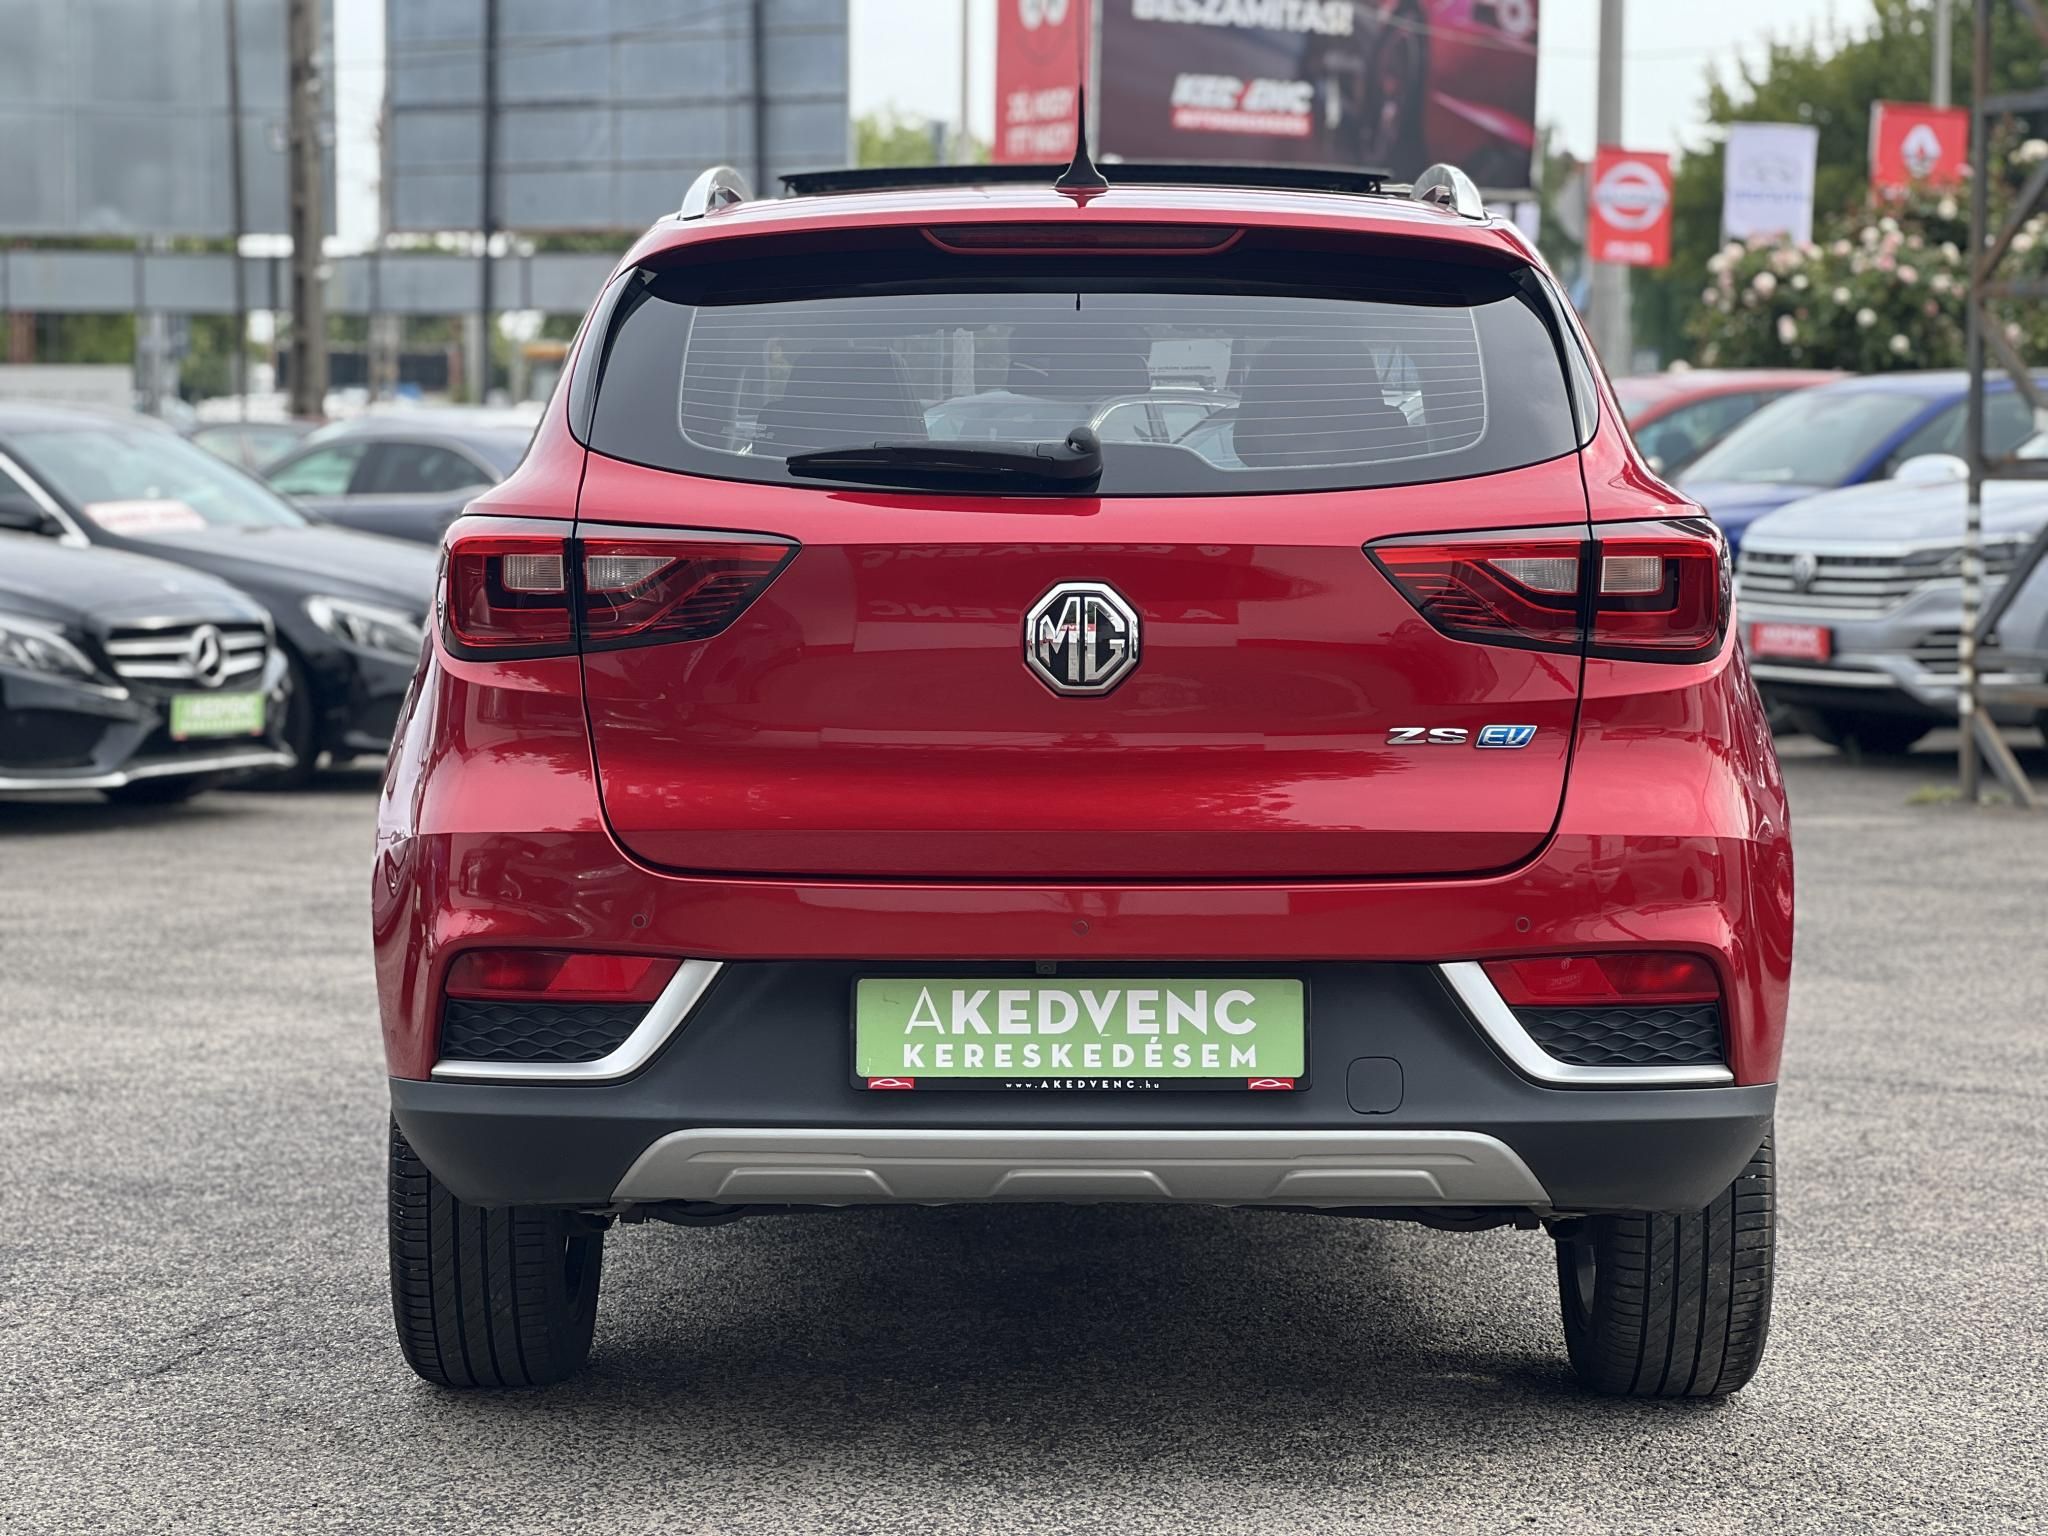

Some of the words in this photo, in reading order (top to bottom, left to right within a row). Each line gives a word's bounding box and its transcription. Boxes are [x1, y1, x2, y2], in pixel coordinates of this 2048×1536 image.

[1039, 596, 1125, 682] MG
[1387, 727, 1469, 745] ZS
[1482, 727, 1530, 745] EV
[904, 986, 1257, 1036] AKEDVENC
[903, 1036, 1257, 1069] KERESKEDÉSEM
[1005, 1080, 1160, 1089] www.AKEDVENC.hu
